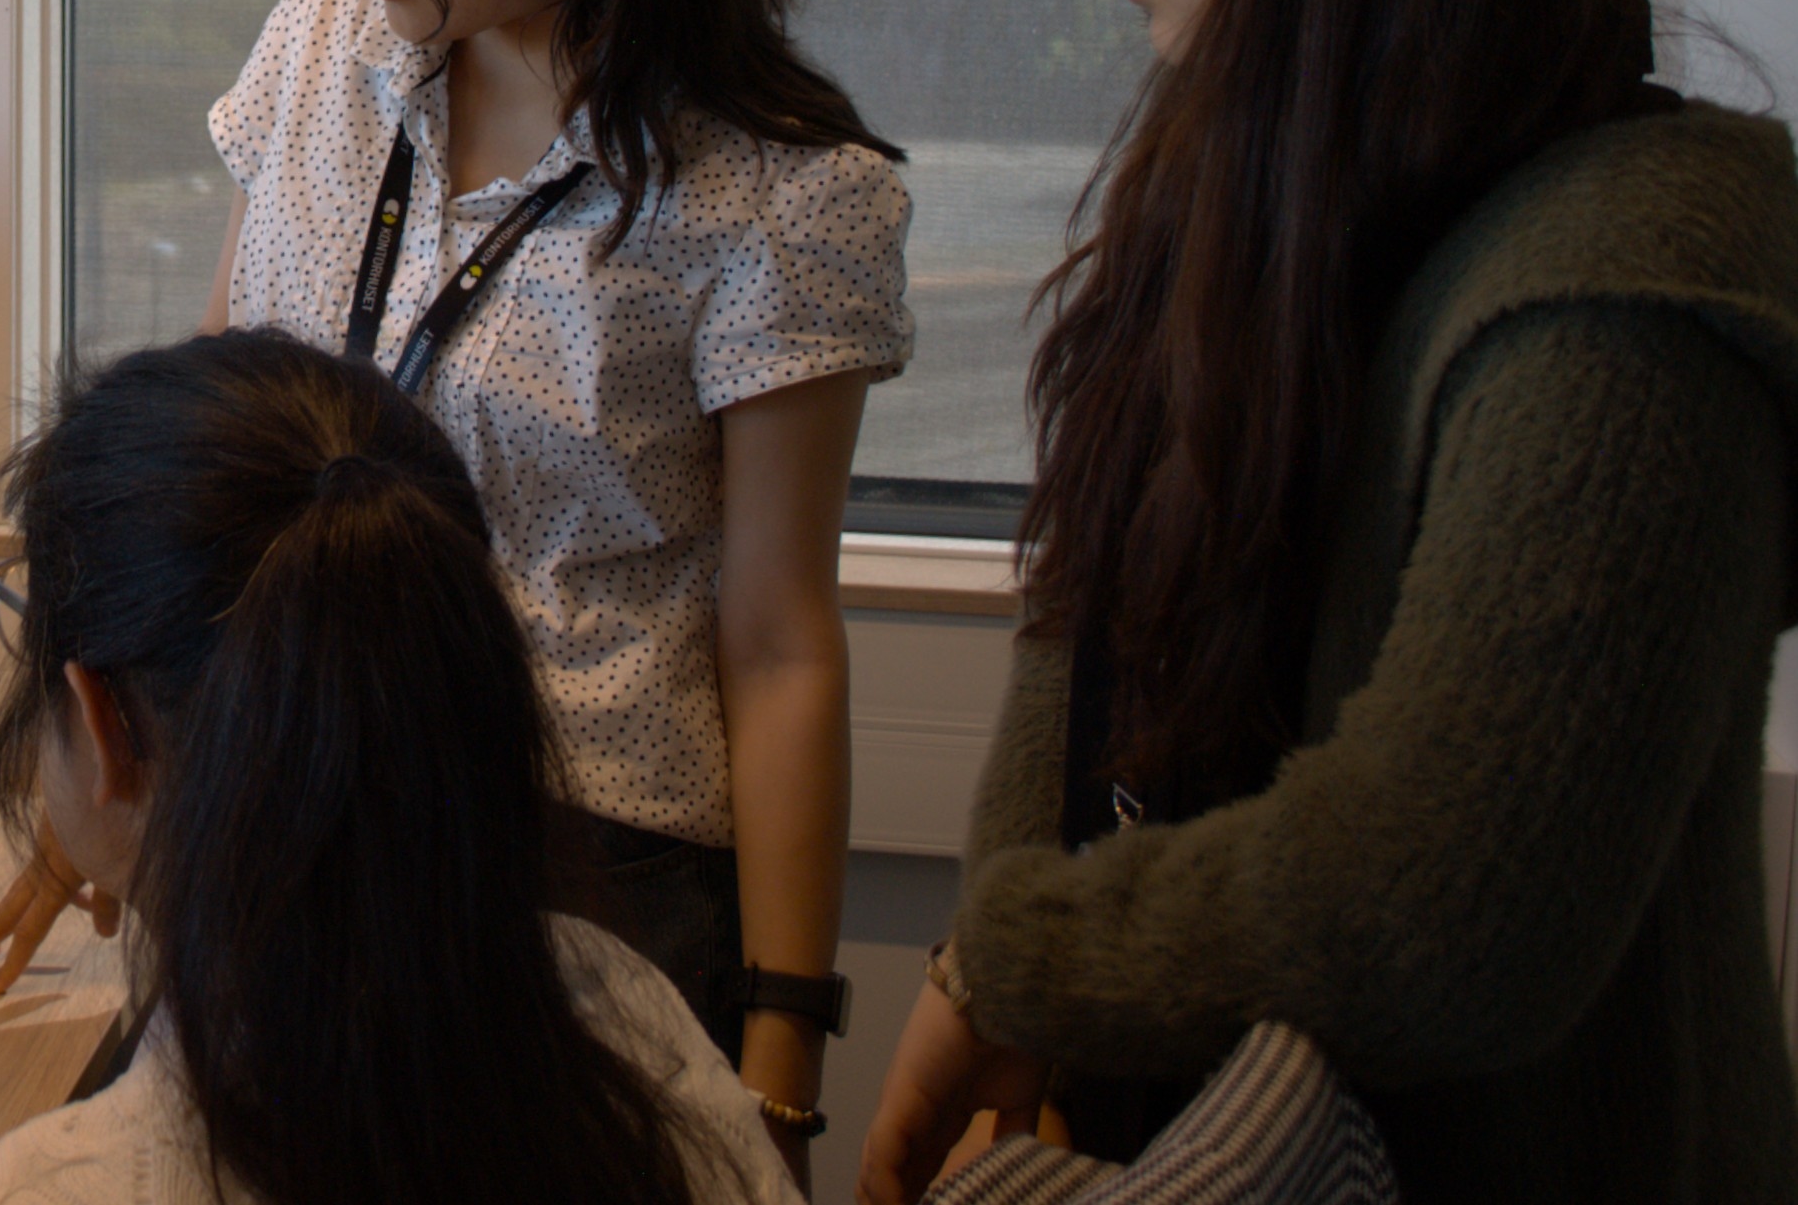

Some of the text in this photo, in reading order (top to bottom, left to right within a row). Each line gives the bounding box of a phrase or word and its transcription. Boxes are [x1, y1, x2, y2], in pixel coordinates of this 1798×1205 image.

[479, 196, 546, 265] KONTORHUSET
[362, 227, 392, 313] KONTORHUSET
[398, 328, 434, 388] TORHUSET
